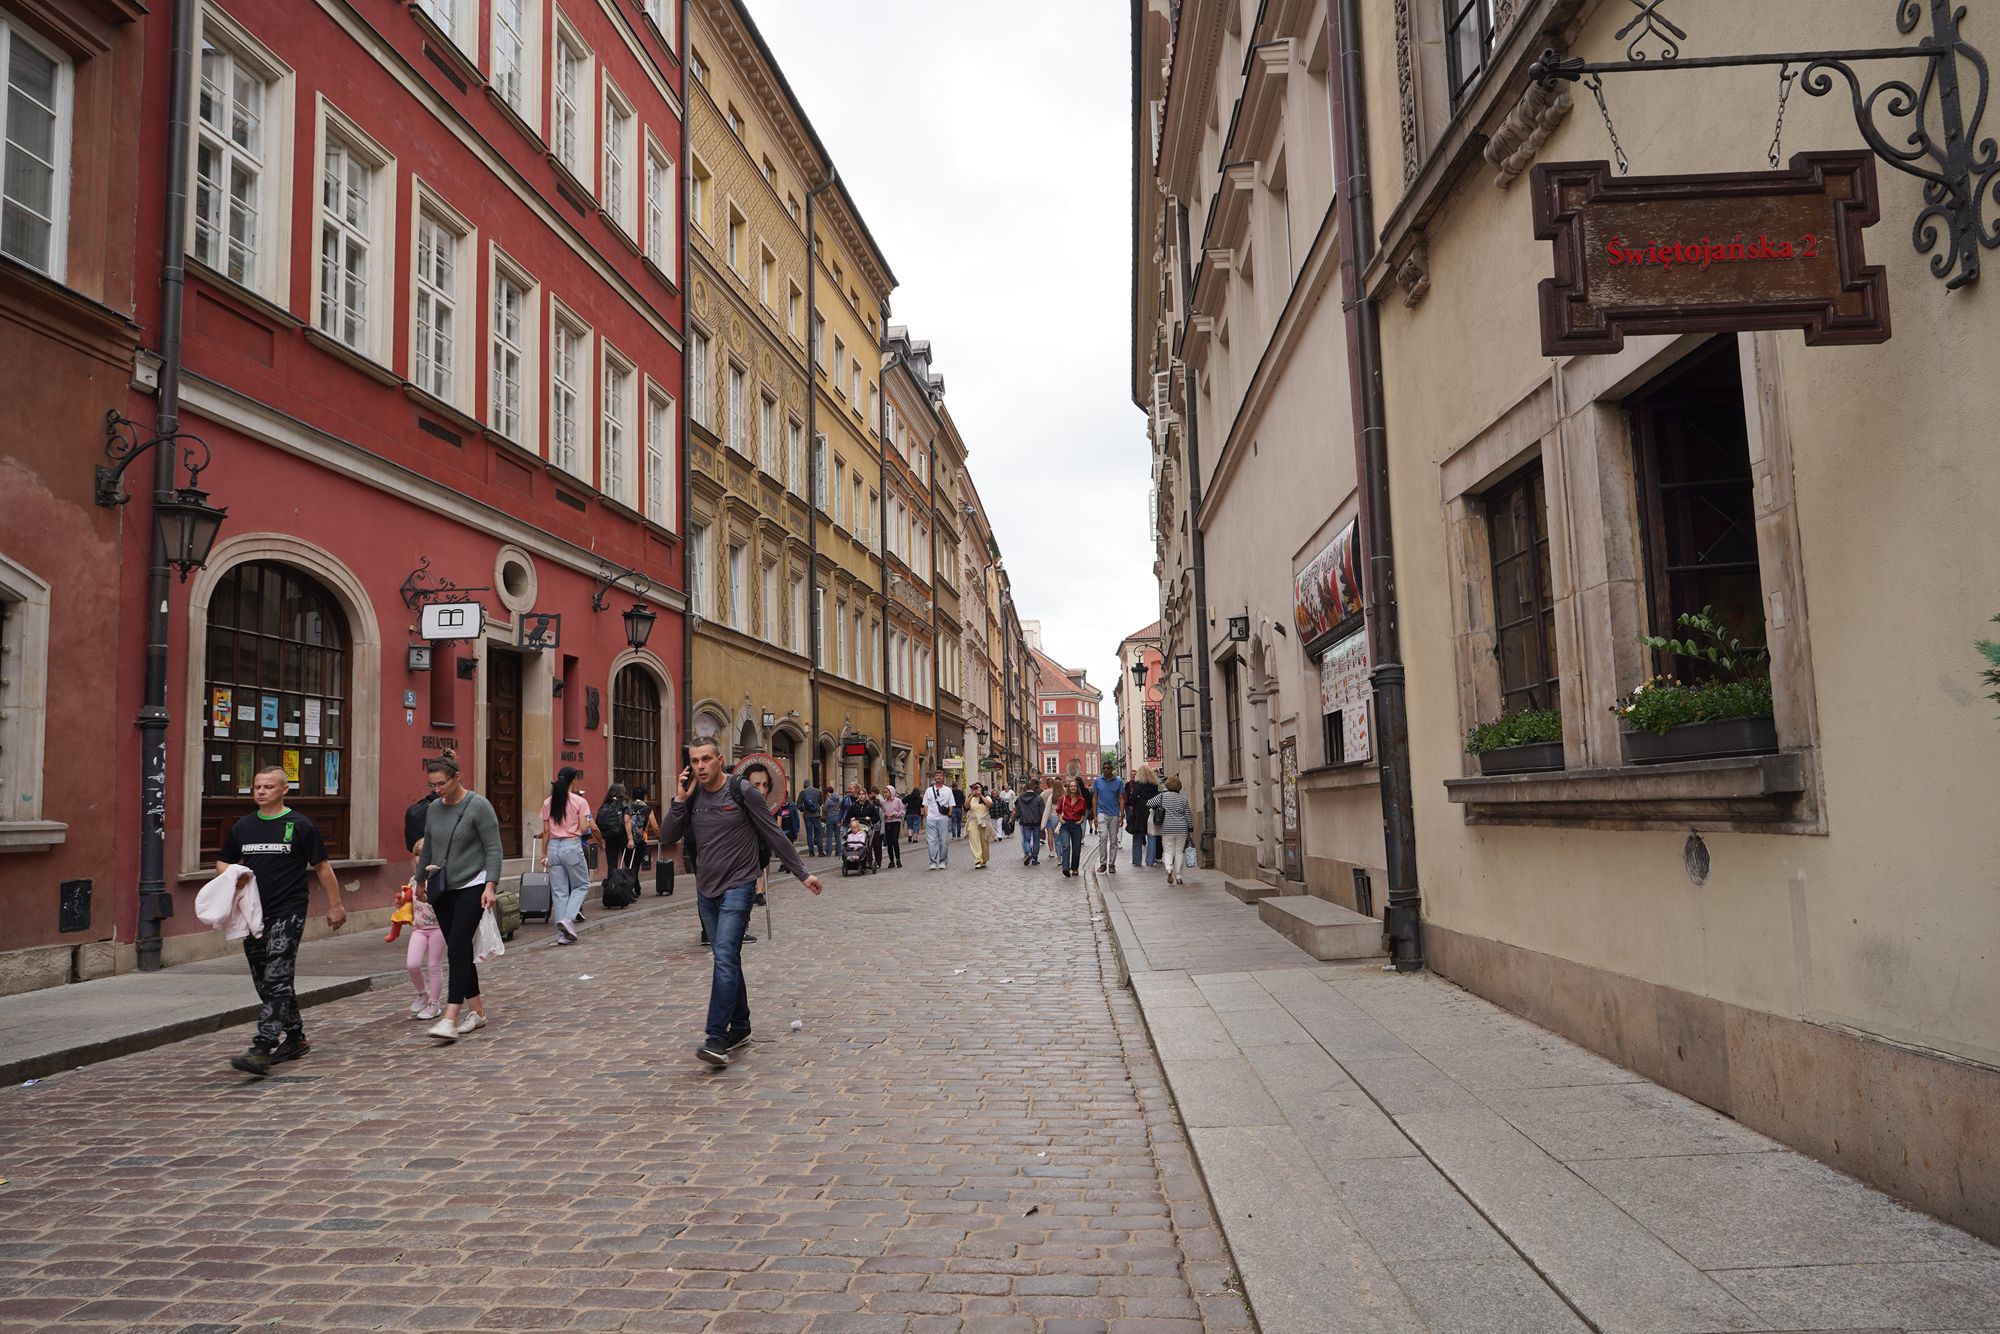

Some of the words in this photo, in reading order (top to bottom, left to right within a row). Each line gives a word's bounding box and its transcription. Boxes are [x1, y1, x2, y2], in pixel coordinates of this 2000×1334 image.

[1606, 234, 1794, 271] Świętojańska
[1801, 234, 1819, 258] 2
[1231, 620, 1238, 629] 4
[1238, 627, 1245, 637] 6
[416, 650, 424, 661] 5
[408, 692, 413, 702] 5
[422, 736, 458, 749] BIBLIOTEKA
[736, 757, 758, 774] CHOPIN
[759, 757, 782, 776] CONCERT
[242, 843, 291, 854] MINECRAFT
